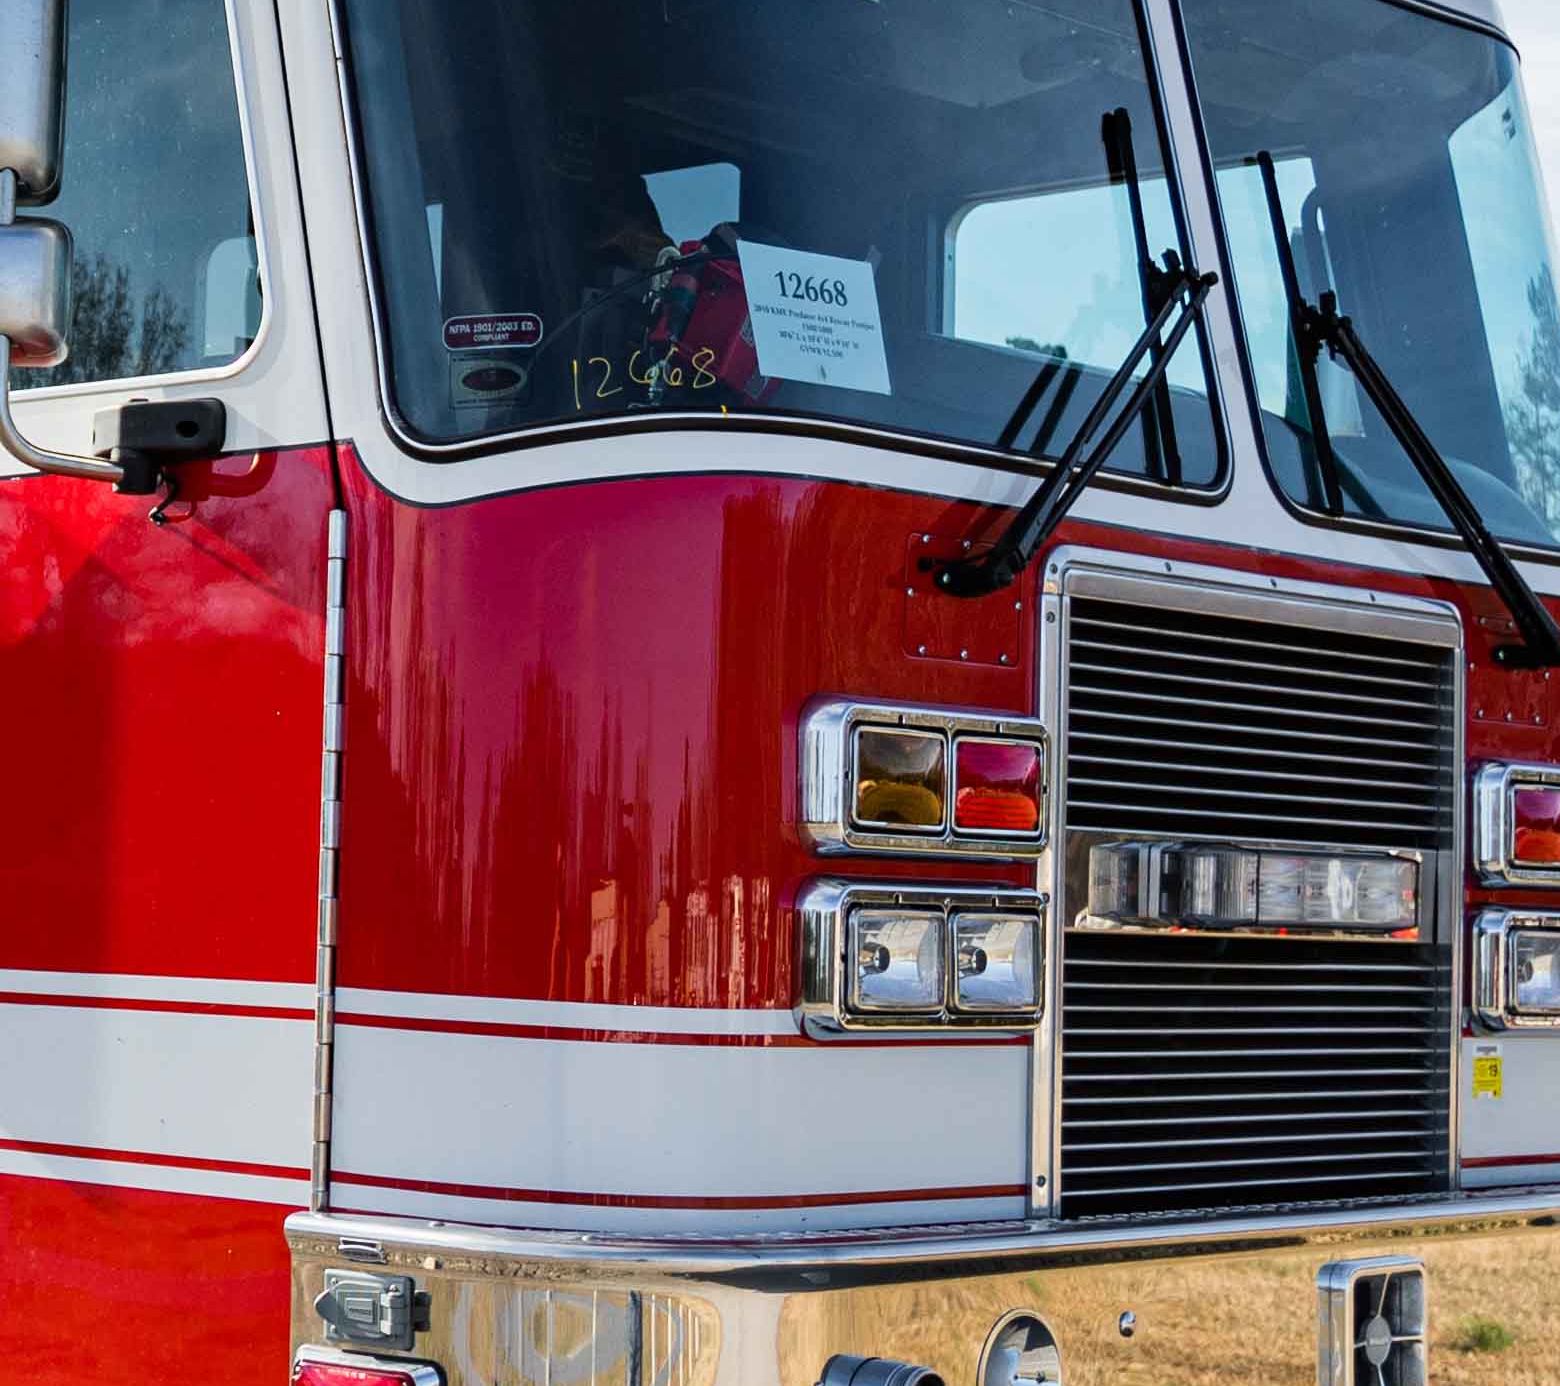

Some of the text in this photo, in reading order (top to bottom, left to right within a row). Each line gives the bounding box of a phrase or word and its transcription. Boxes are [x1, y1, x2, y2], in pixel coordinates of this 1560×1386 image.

[774, 270, 848, 307] 12668
[449, 324, 470, 334] NFPA
[472, 321, 518, 333] 1901/2003
[472, 333, 509, 342] COMPLIANT
[571, 347, 716, 410] 12668
